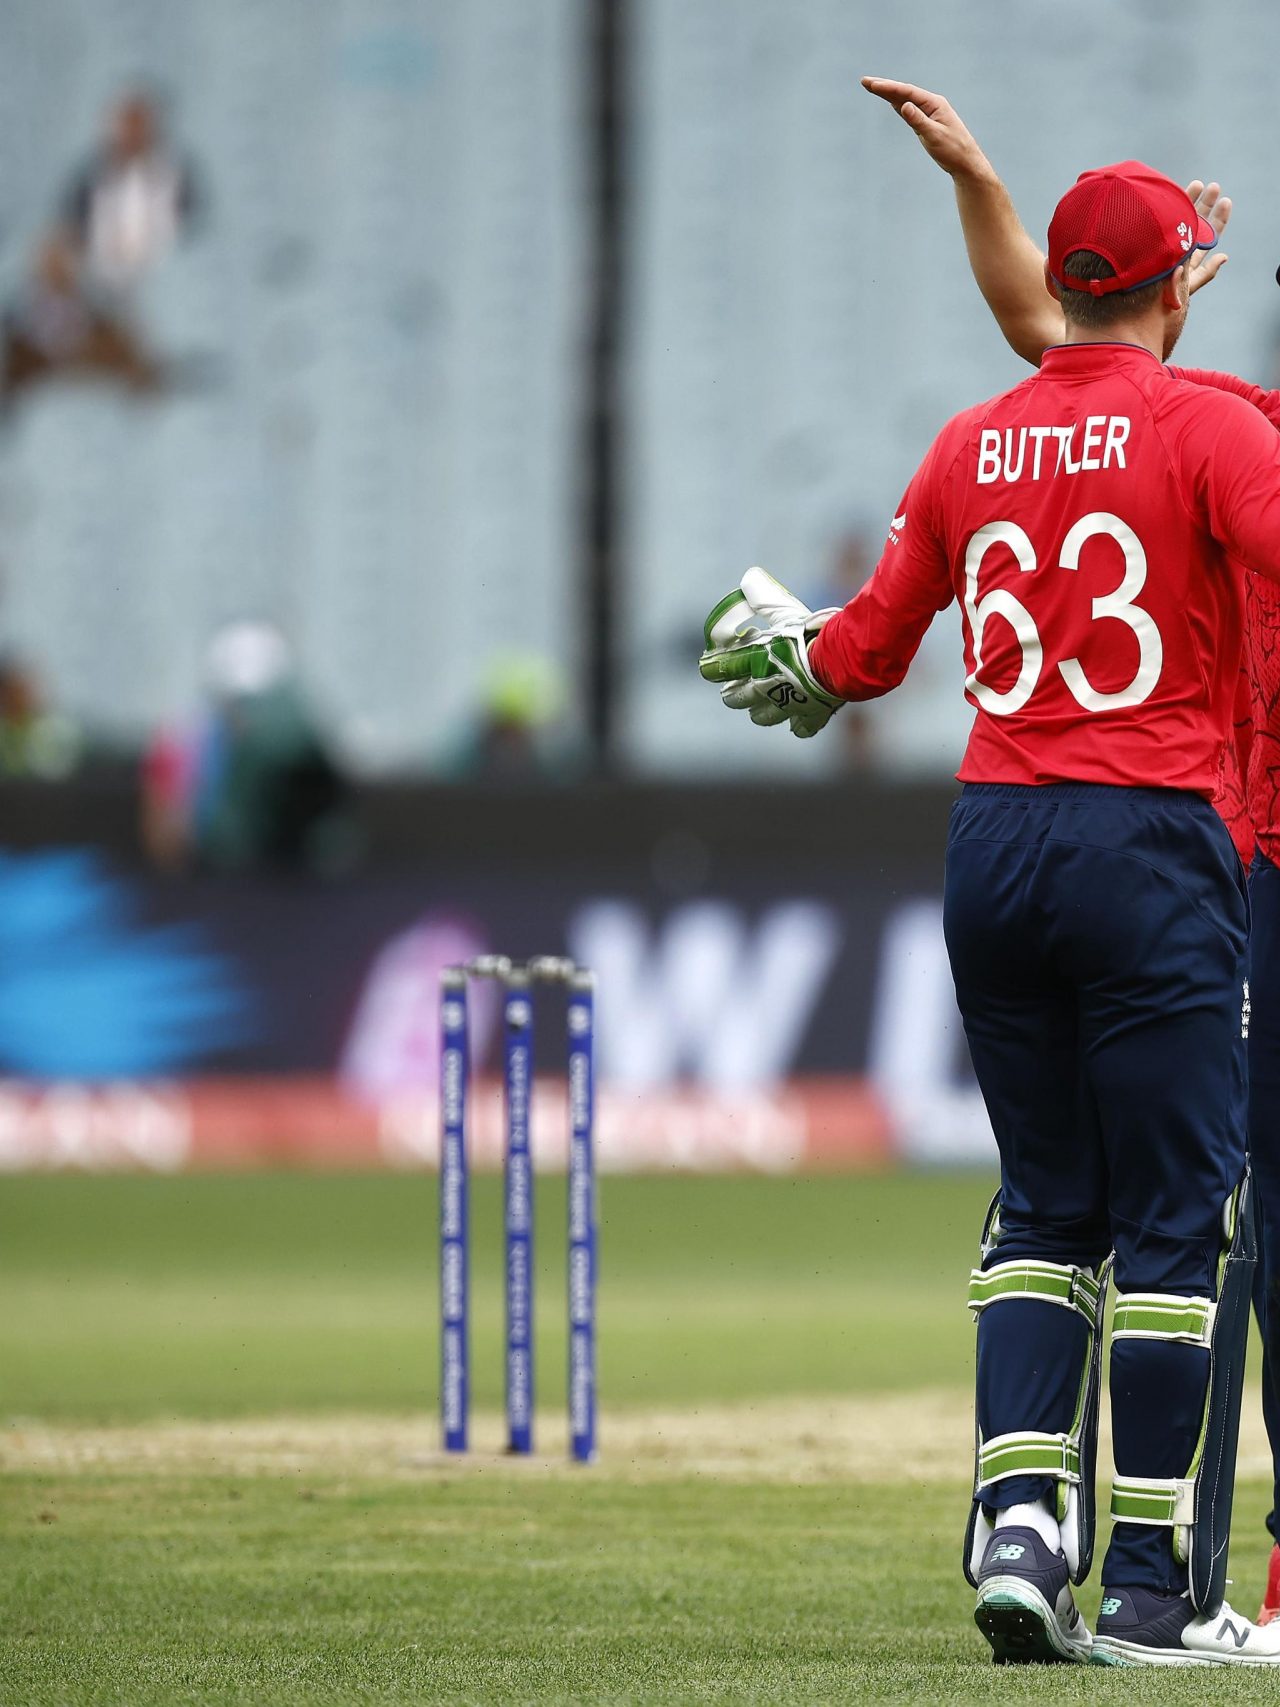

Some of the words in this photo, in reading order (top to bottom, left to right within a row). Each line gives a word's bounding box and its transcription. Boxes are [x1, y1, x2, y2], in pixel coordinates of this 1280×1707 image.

[976, 415, 1131, 484] BUTTLER
[964, 511, 1164, 716] 63
[1216, 1618, 1250, 1648] N
